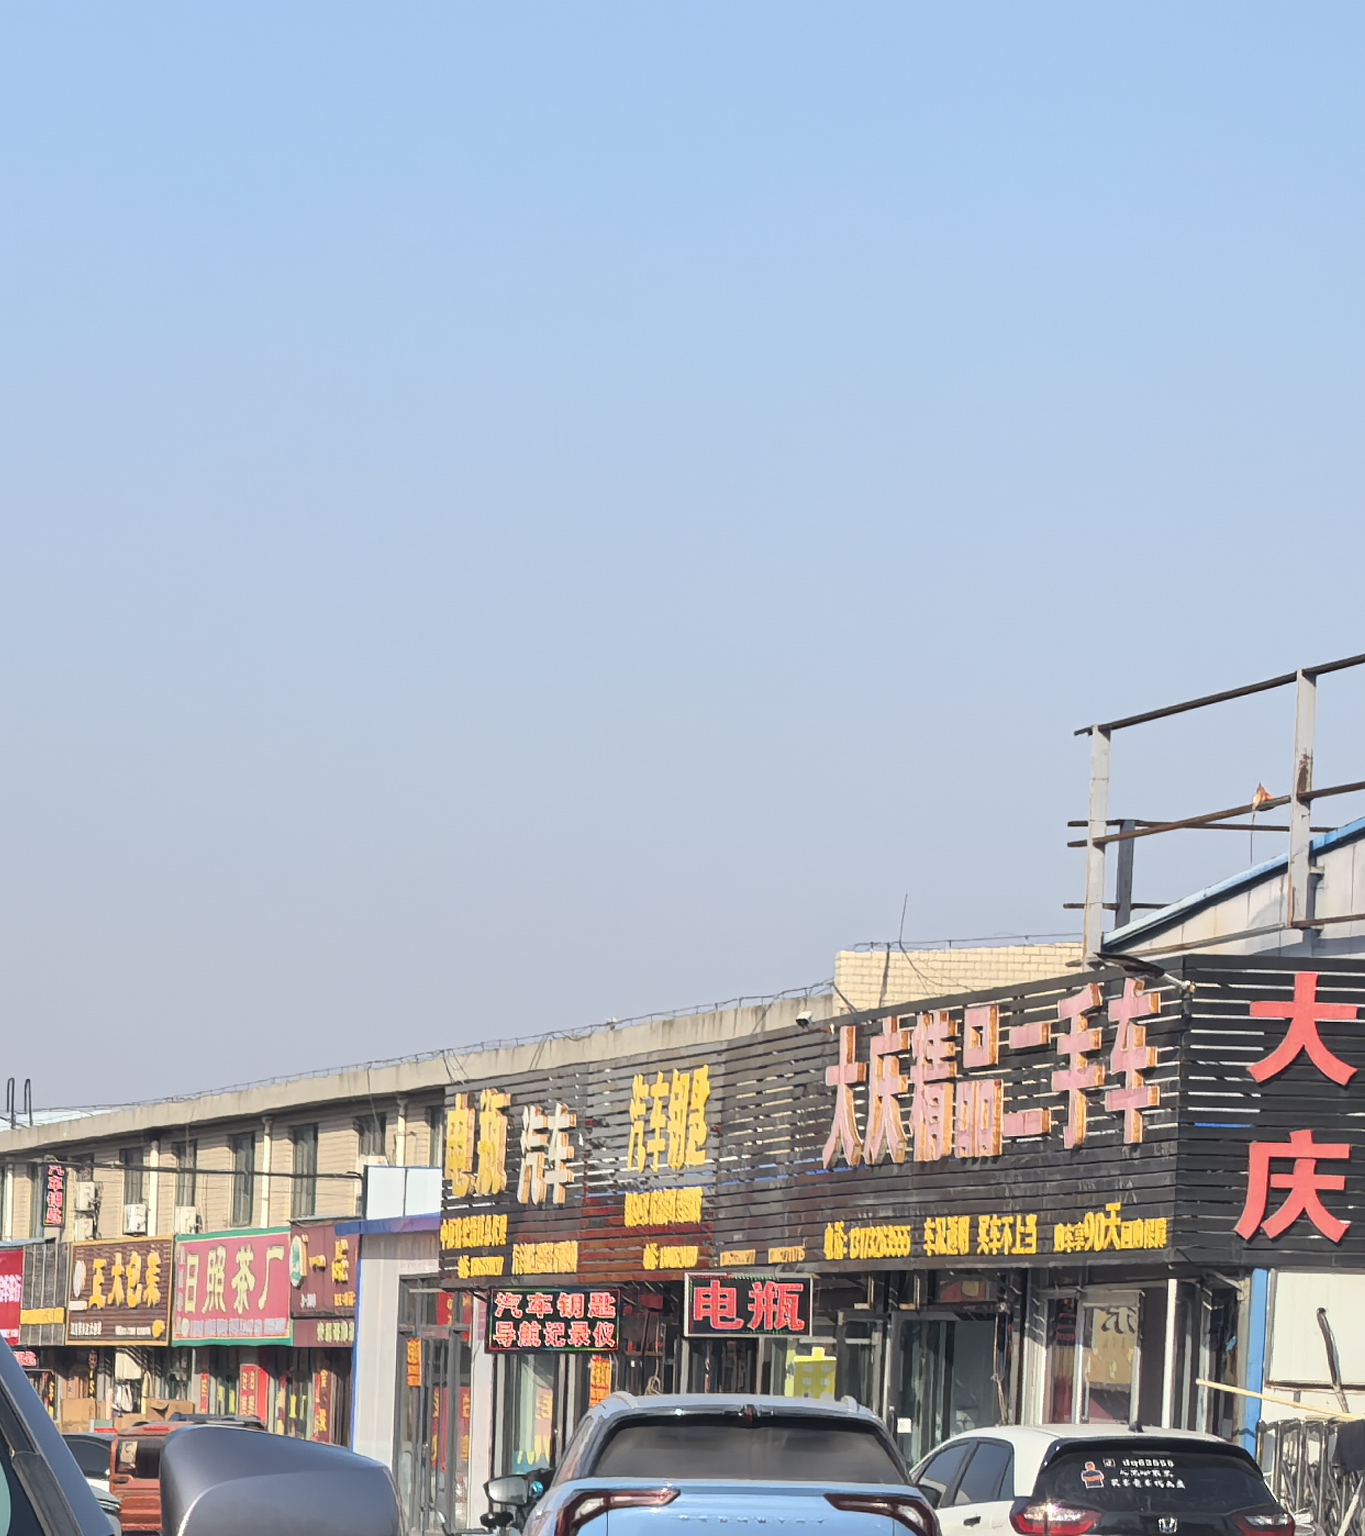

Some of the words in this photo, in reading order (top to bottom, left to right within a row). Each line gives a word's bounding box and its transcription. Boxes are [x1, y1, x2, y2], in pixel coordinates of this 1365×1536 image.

[823, 977, 1162, 1168] 大庆精品二手车
[1234, 972, 1358, 1243] 大庆
[184, 1243, 286, 1315] 日照茶厂
[494, 1292, 617, 1319] 汽车钥匙
[692, 1280, 805, 1332] 电瓶
[493, 1321, 617, 1348] 导航记录仪
